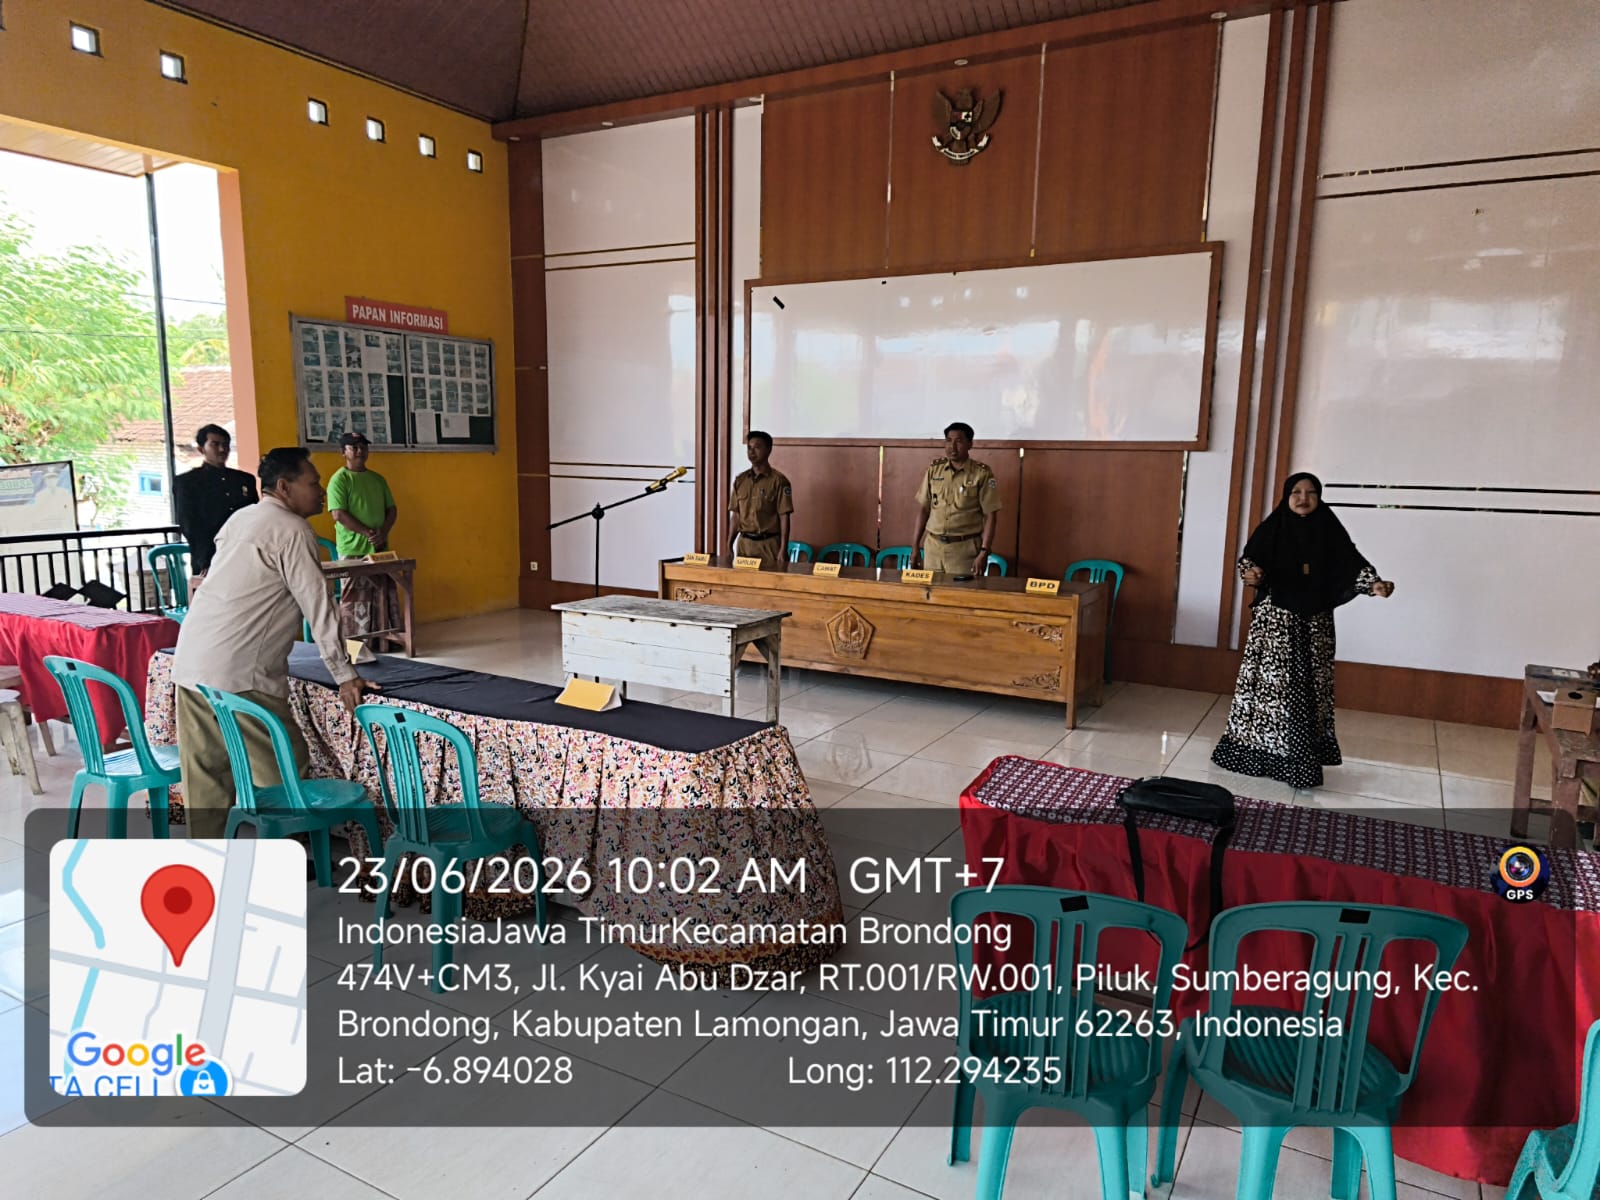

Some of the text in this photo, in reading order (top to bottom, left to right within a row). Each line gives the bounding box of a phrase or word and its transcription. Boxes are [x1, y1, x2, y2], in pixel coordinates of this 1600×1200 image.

[352, 304, 443, 330] PAPAN INFORMASI
[1030, 581, 1056, 590] BPD
